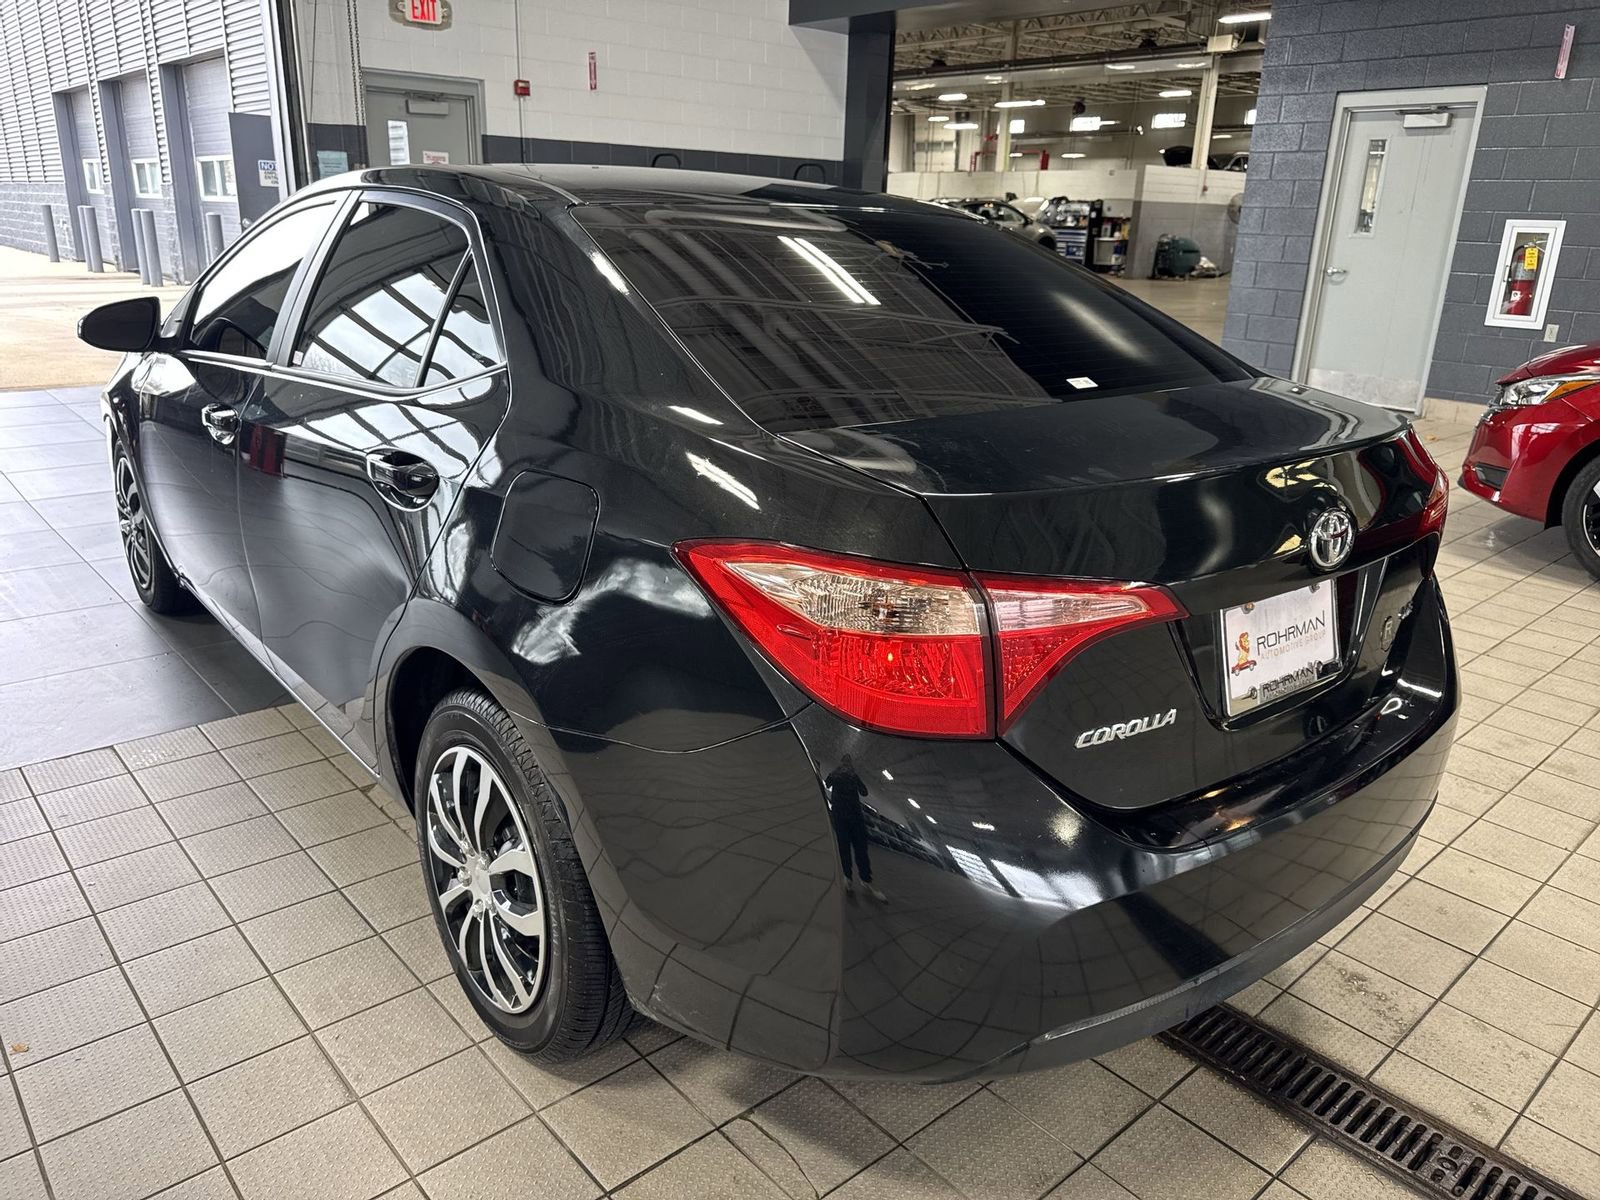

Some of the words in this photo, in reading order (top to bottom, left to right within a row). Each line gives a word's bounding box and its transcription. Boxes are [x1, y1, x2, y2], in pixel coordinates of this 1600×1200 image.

[411, 0, 437, 22] EXIT
[1256, 610, 1325, 656] ROHRMAN
[1260, 637, 1304, 661] AUTOMOTIVE
[1305, 628, 1326, 645] GROUP
[1262, 662, 1314, 698] ROHRMAN
[1075, 708, 1177, 749] COROLLA
